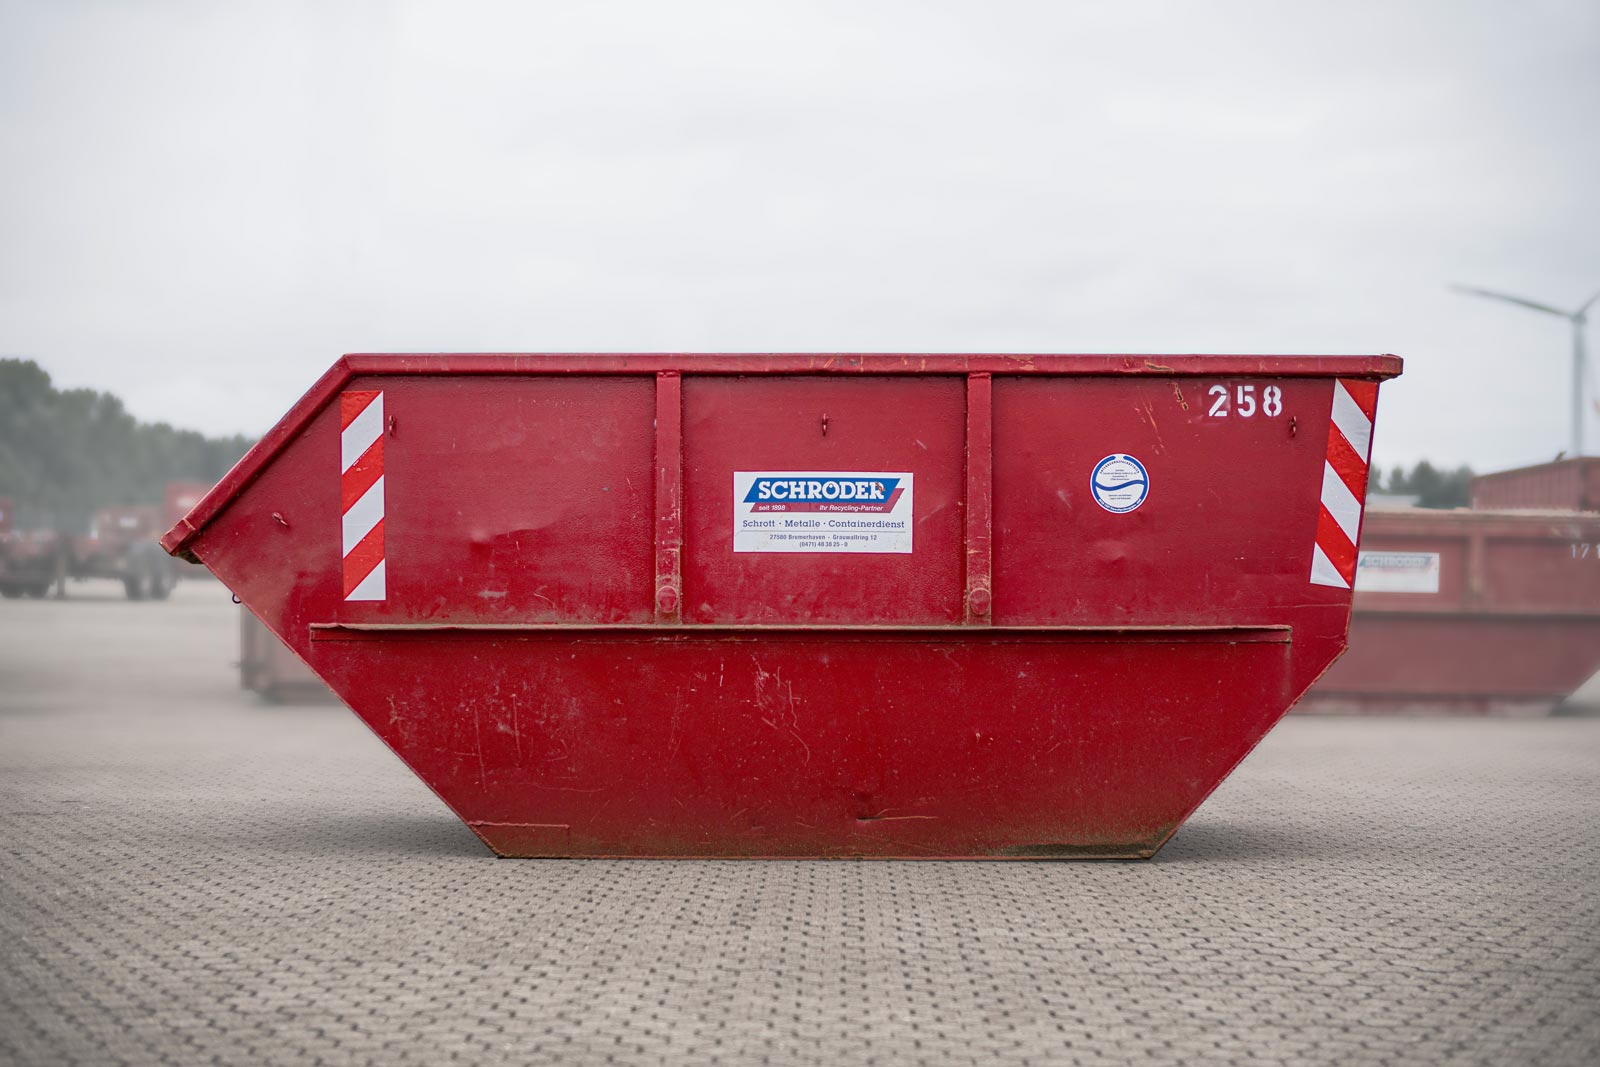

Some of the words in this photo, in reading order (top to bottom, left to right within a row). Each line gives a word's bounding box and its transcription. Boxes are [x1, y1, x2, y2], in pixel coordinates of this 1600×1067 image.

[1208, 385, 1282, 417] 258
[829, 504, 883, 512] Recycling-Partner
[742, 520, 775, 528] Schrott
[784, 520, 821, 528] Metalle
[828, 519, 905, 528] Containerdienst
